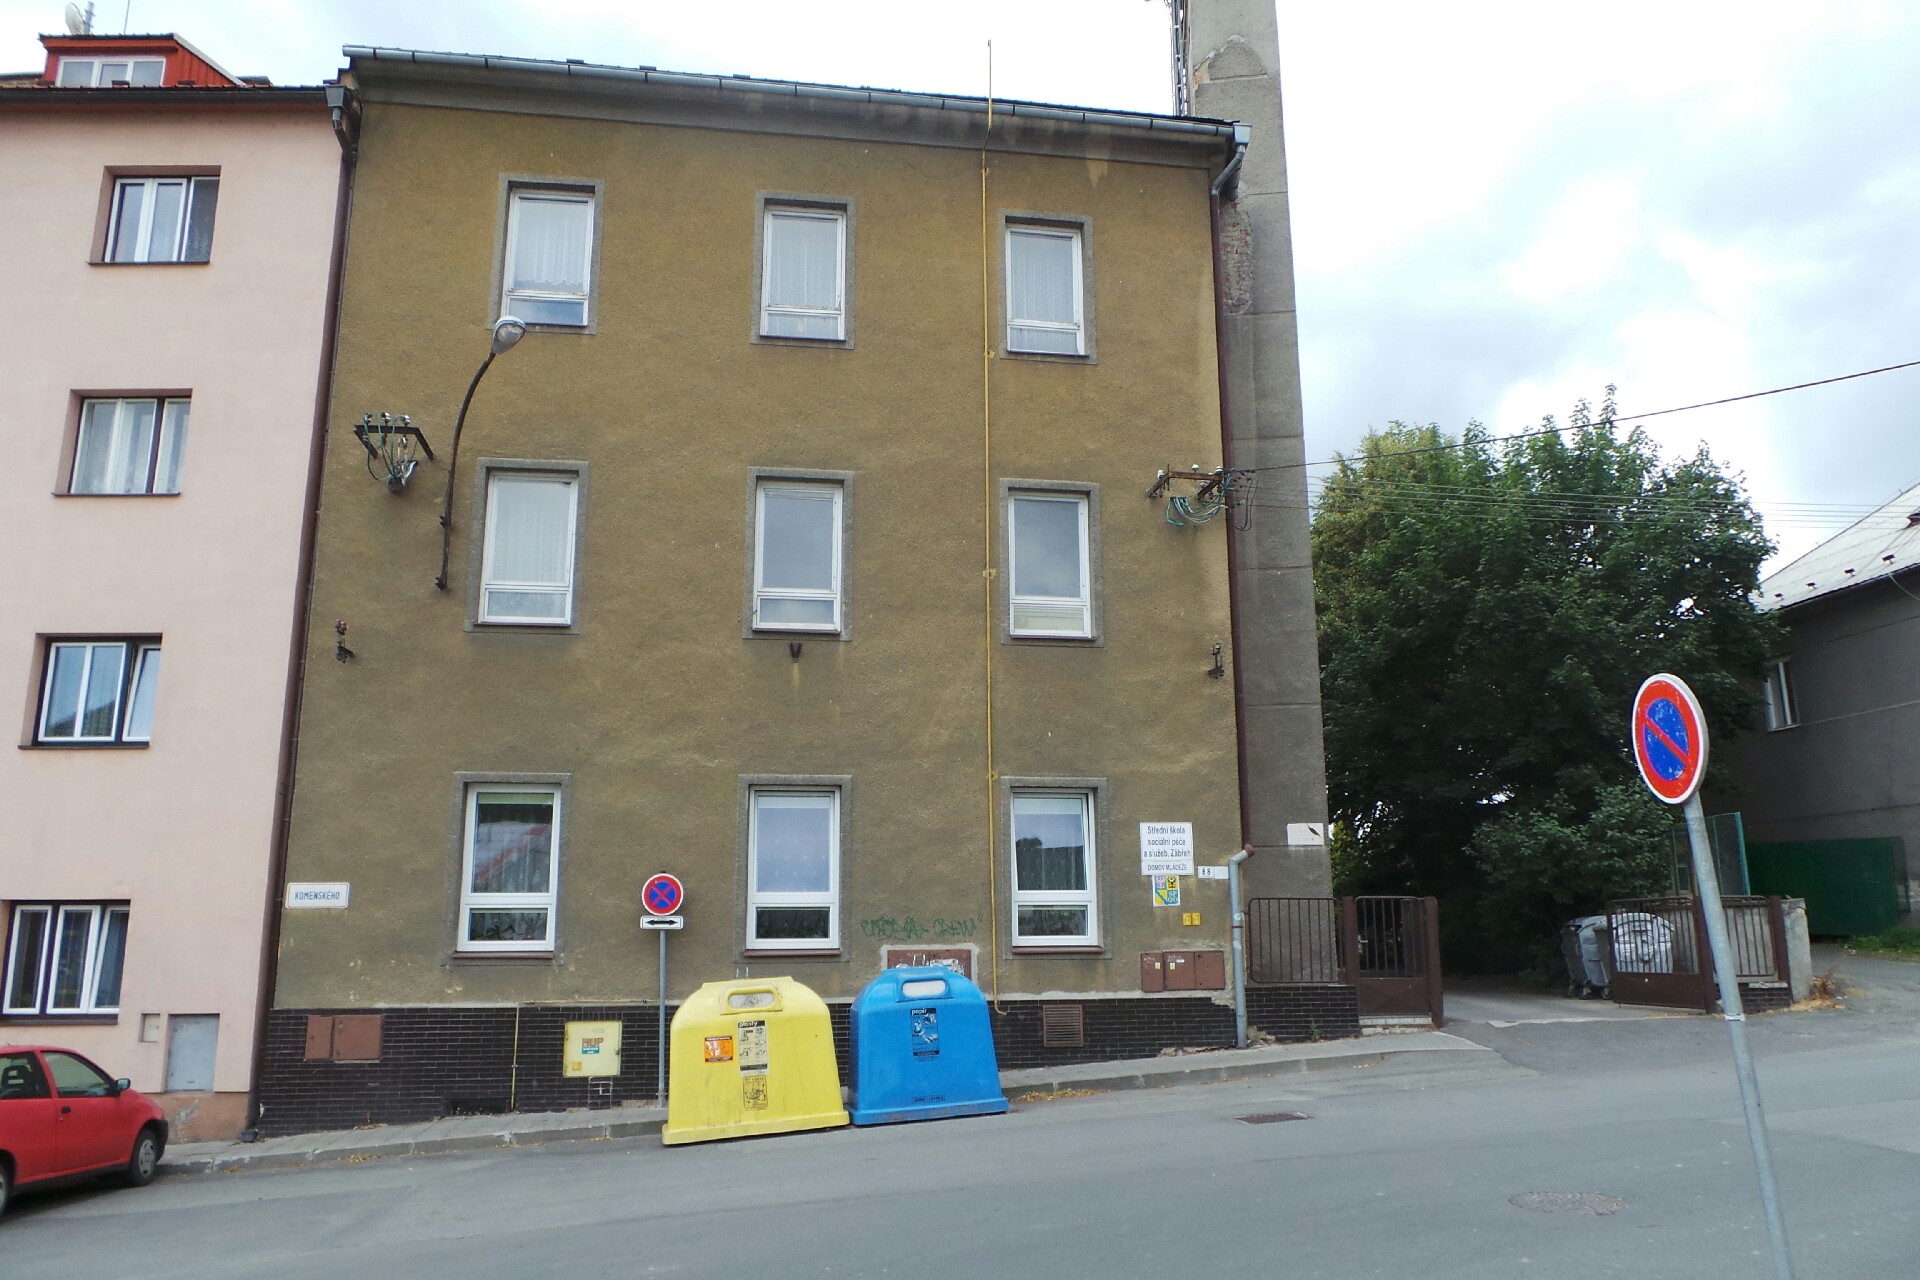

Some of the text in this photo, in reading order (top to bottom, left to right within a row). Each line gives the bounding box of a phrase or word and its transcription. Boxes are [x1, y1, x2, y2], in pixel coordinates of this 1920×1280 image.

[1147, 825, 1186, 835] Střední škola
[1147, 837, 1186, 847] sociální péče
[1166, 862, 1188, 871] MLÁDEŽE
[294, 890, 340, 900] KOMENSKÉHO
[582, 1037, 604, 1047] HUP
